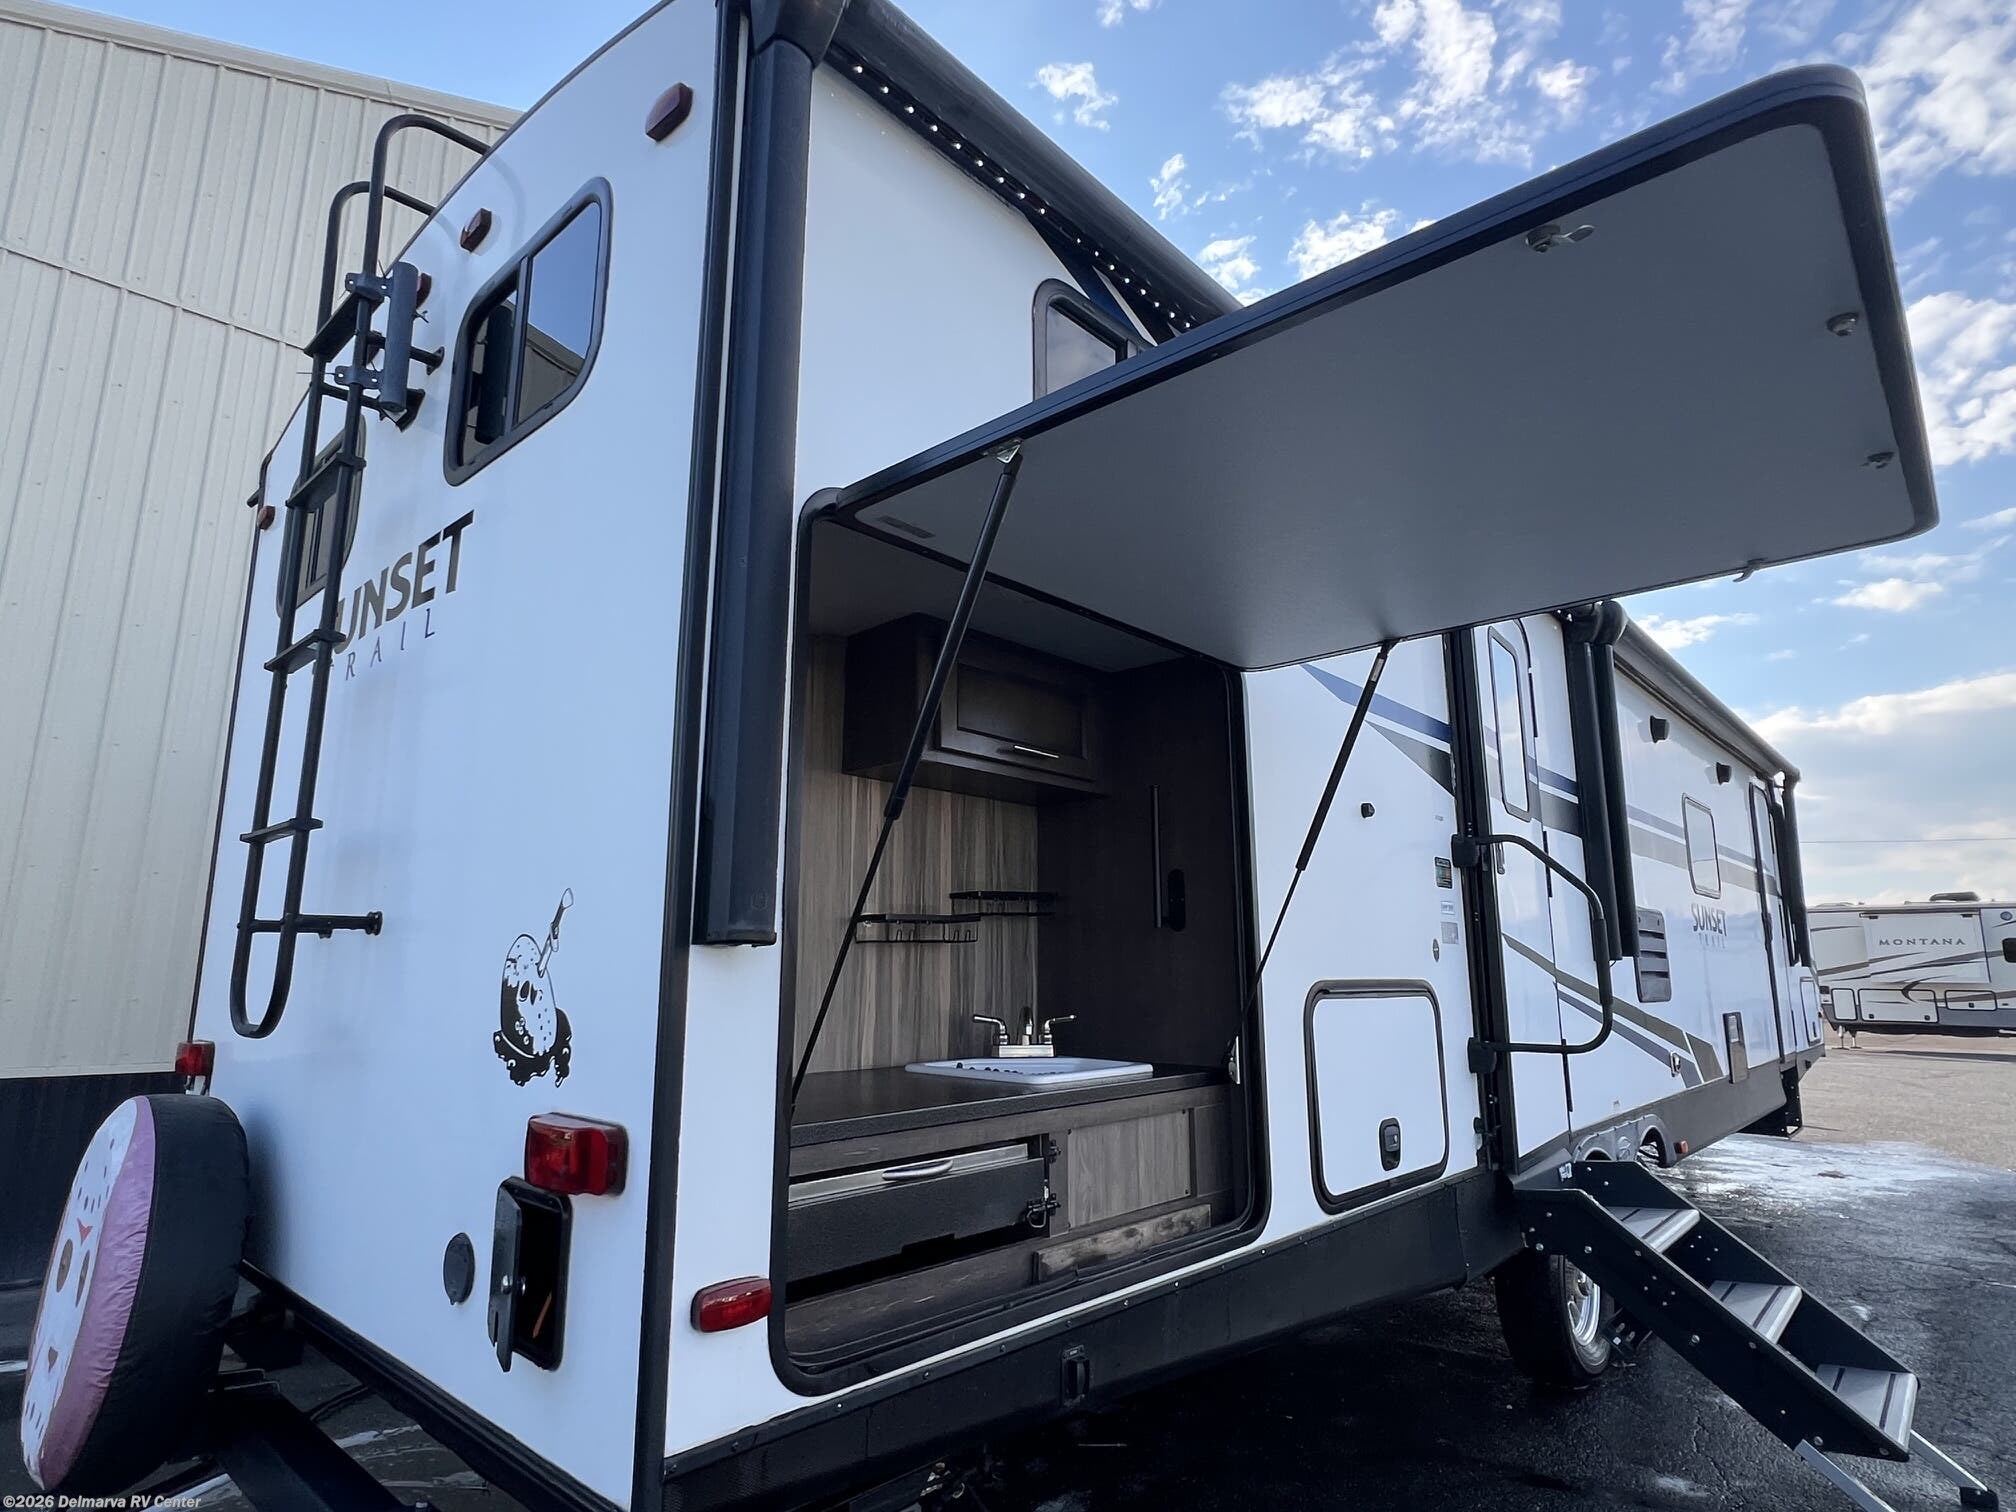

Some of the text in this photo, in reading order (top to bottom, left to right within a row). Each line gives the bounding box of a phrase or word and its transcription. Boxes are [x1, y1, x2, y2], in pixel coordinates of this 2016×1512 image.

[333, 509, 475, 655] UNSET
[313, 608, 435, 681] RAIL
[1691, 903, 1727, 937] SUNSET
[1879, 938, 1966, 946] MONTANA
